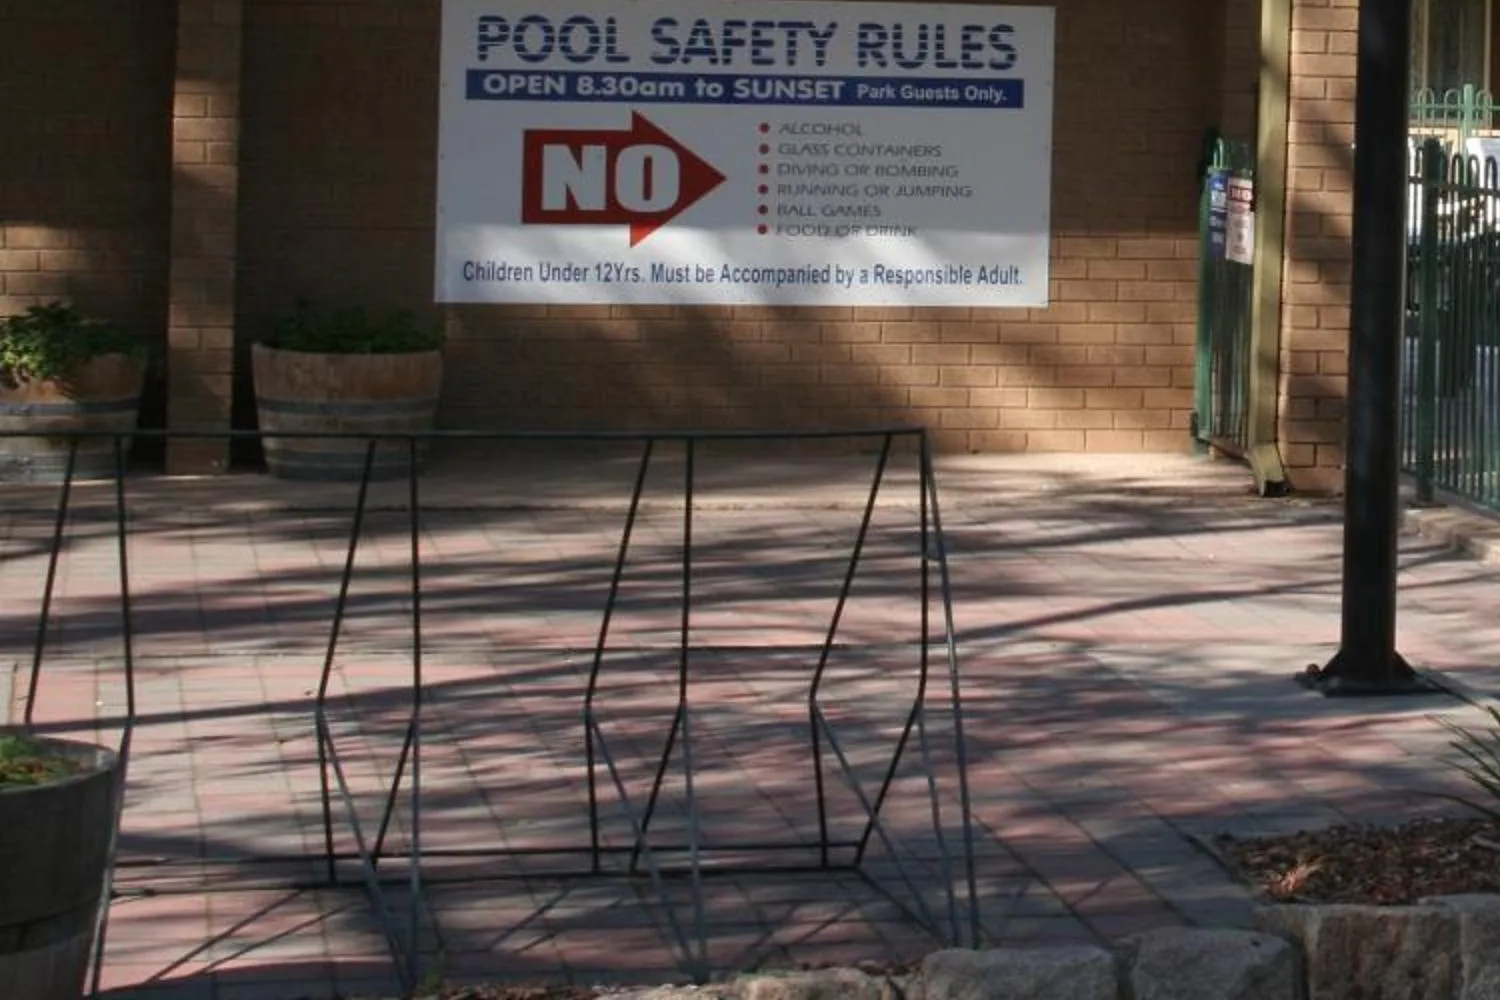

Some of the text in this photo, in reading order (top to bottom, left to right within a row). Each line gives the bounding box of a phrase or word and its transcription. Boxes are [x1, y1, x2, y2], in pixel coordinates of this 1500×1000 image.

[477, 14, 1017, 70] POOL SAFETY RULES
[483, 74, 1008, 104] OPEN 8.30am to SUNSET Park Guests Only.
[778, 122, 863, 136] ALCOHOL
[778, 143, 943, 158] GLASS CONTAINERS
[540, 143, 680, 213] NO
[777, 163, 959, 179] DIVING OR BOMBING
[777, 184, 973, 199] RUNNING OR JUMPING
[777, 204, 881, 218] BALL GAMES
[776, 224, 916, 237] FOOD OR DRINK
[463, 261, 1023, 288] Children Under 12Yrs. Must be Accompanied by a Responsible Adult.
